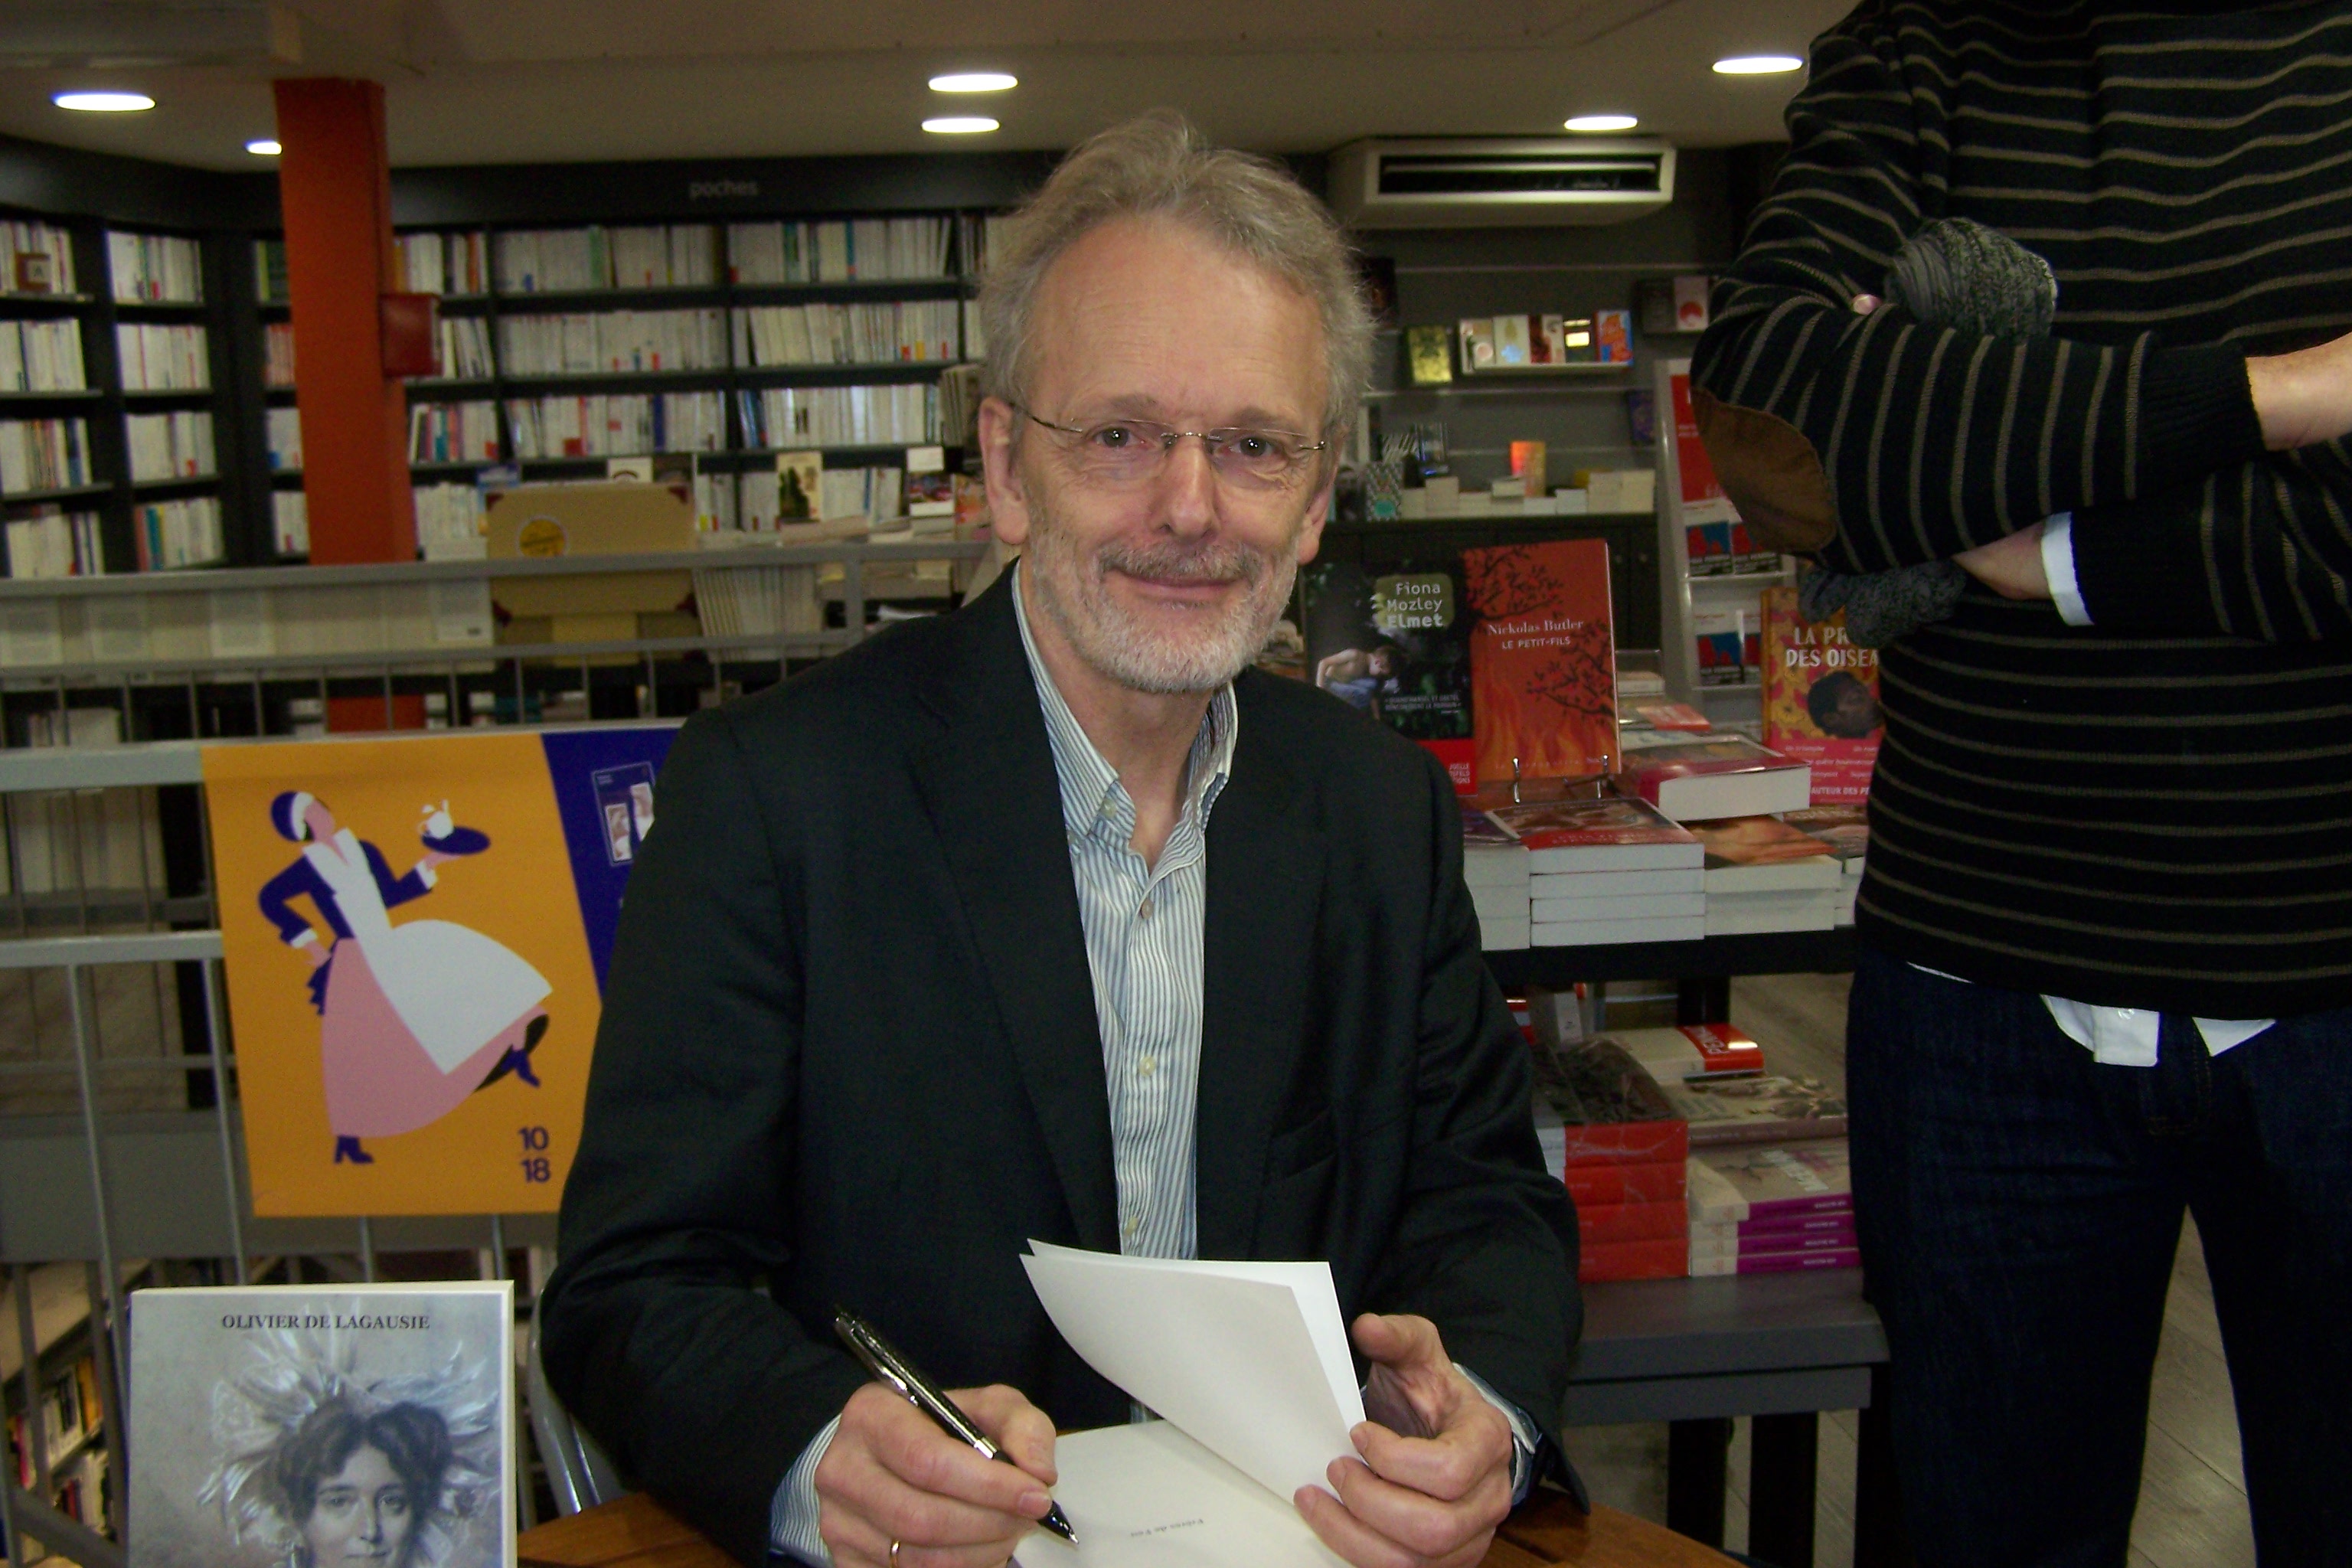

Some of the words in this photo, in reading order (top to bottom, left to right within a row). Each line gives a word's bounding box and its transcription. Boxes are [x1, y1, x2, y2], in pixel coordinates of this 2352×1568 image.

[1396, 582, 1441, 595] Fiona
[1387, 599, 1442, 612] Mozley
[1387, 613, 1443, 629] Elmet
[1488, 622, 1540, 635] Nickolas
[1544, 619, 1583, 631] Butler
[1502, 641, 1514, 649] LE
[1518, 636, 1570, 648] PETIT-FILS
[1794, 627, 1816, 645] LA
[1824, 626, 1850, 645] PR
[1786, 649, 1821, 668] DES
[1827, 648, 1880, 668] OISEA
[518, 1126, 549, 1150] 10
[521, 1158, 550, 1183] 18
[222, 1314, 299, 1329] OLIVIER
[306, 1314, 331, 1329] DE
[335, 1314, 430, 1329] LAGAUSIE
